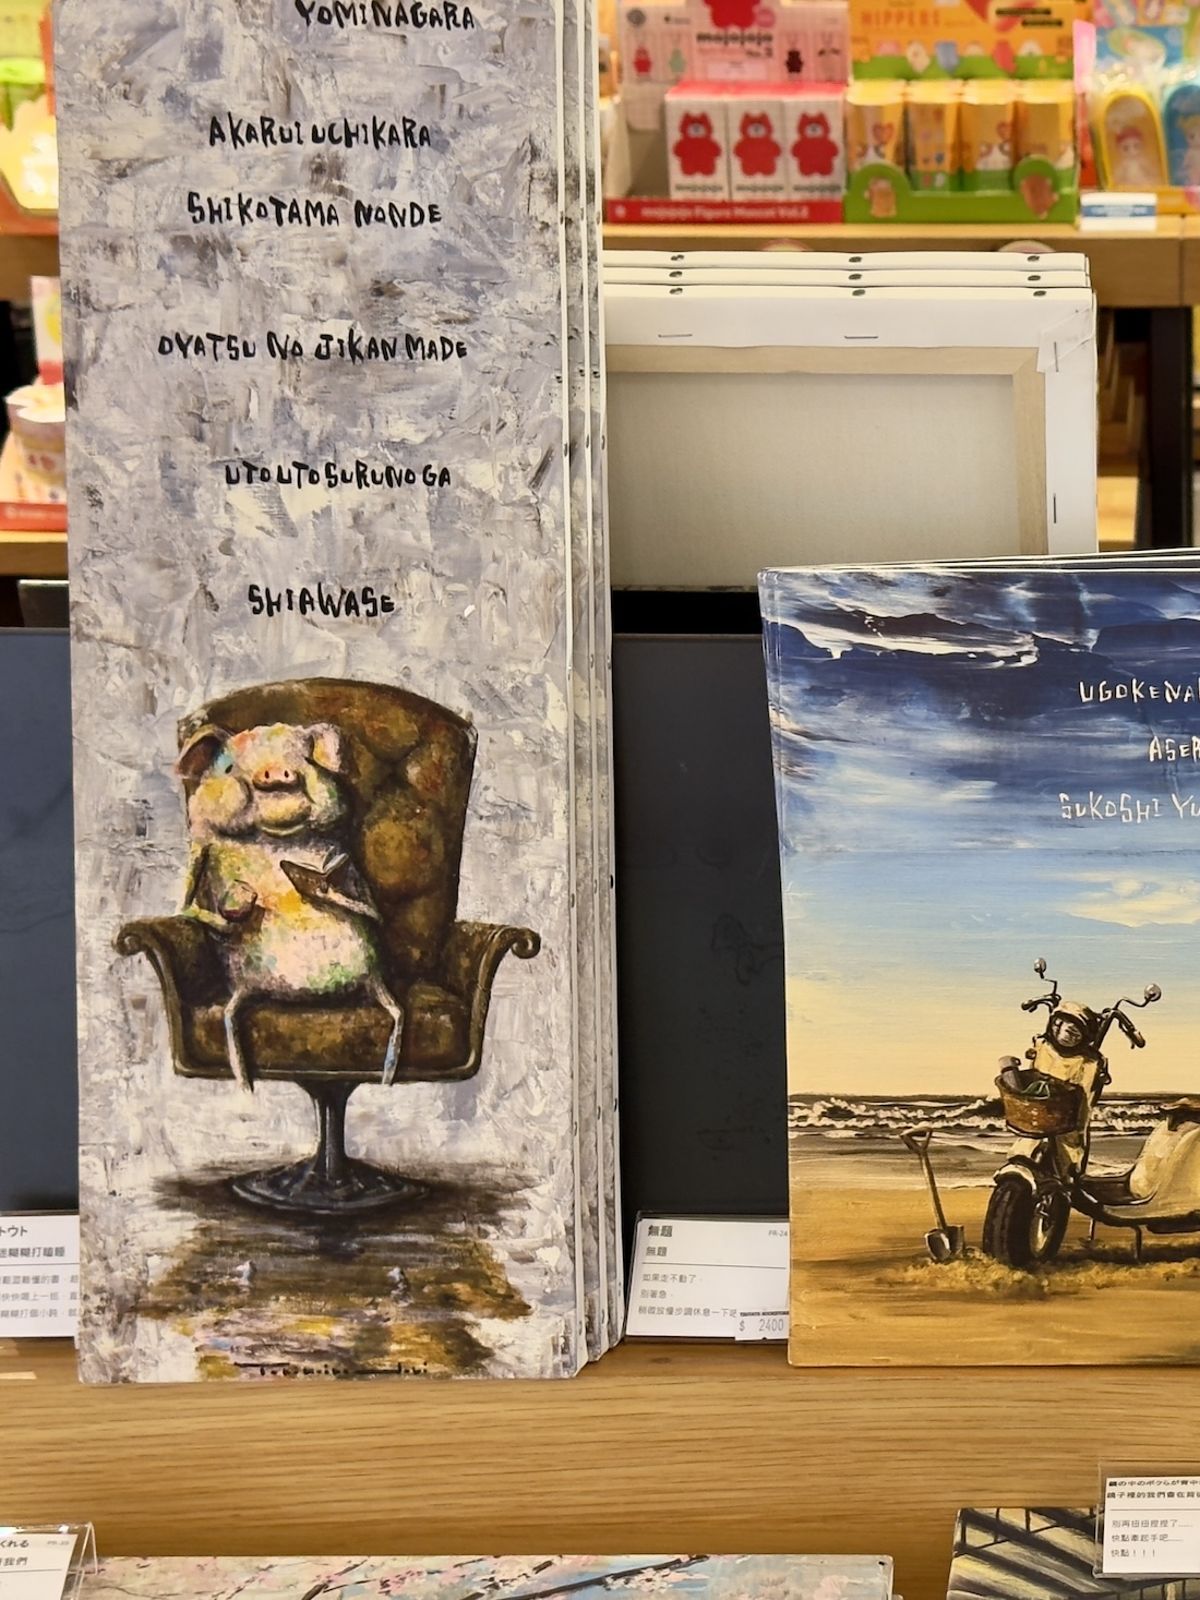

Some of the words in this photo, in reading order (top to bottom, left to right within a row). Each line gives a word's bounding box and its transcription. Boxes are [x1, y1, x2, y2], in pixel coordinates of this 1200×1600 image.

[295, 0, 475, 31] YOMINAGARA
[187, 191, 339, 226] SHIKOTAMA
[354, 199, 442, 228] NONDE
[158, 332, 256, 362] OYATSU
[266, 331, 304, 361] NO
[314, 328, 398, 365] JIKAN
[404, 333, 467, 362] MADE
[248, 582, 395, 618] SHIAWASE
[1059, 791, 1160, 823] SUKOSHI
[648, 1225, 673, 1237] 無題
[645, 1247, 668, 1257] 無題
[739, 1320, 746, 1332] $
[759, 1318, 784, 1332] 2400
